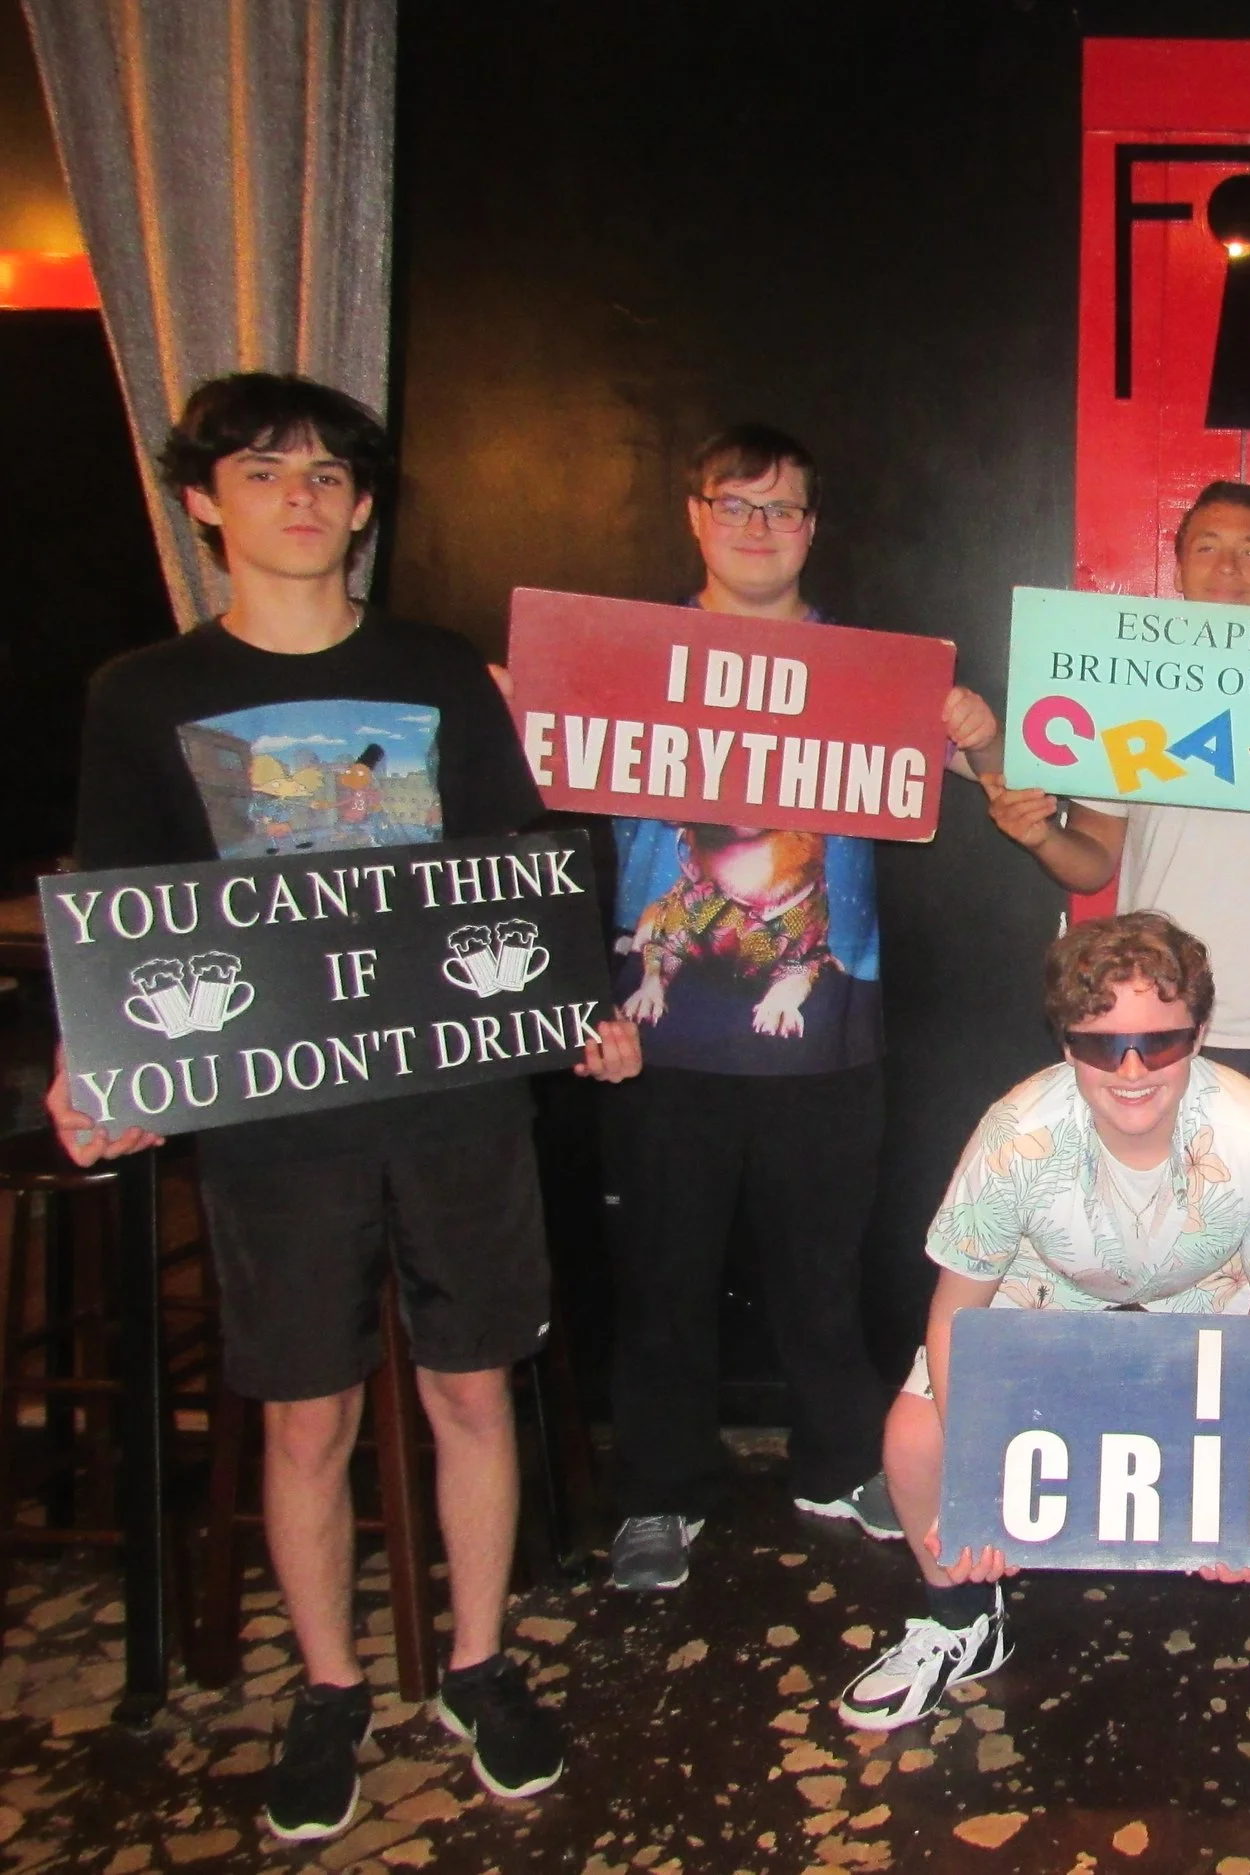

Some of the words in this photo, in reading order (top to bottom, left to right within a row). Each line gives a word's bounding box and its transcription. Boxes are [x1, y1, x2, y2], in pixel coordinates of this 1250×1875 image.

[667, 644, 689, 703] I
[704, 648, 808, 716] DID
[1050, 652, 1204, 693] BRINGS
[524, 711, 927, 819] EVERYTHING
[57, 881, 201, 945] YOU
[221, 865, 396, 928] CAN'T
[411, 849, 585, 909] THINK
[326, 949, 379, 1002] IF
[79, 1055, 220, 1122] YOU
[241, 1025, 417, 1100] DON'T
[432, 1001, 603, 1070] DRINK
[1195, 1329, 1222, 1420] I
